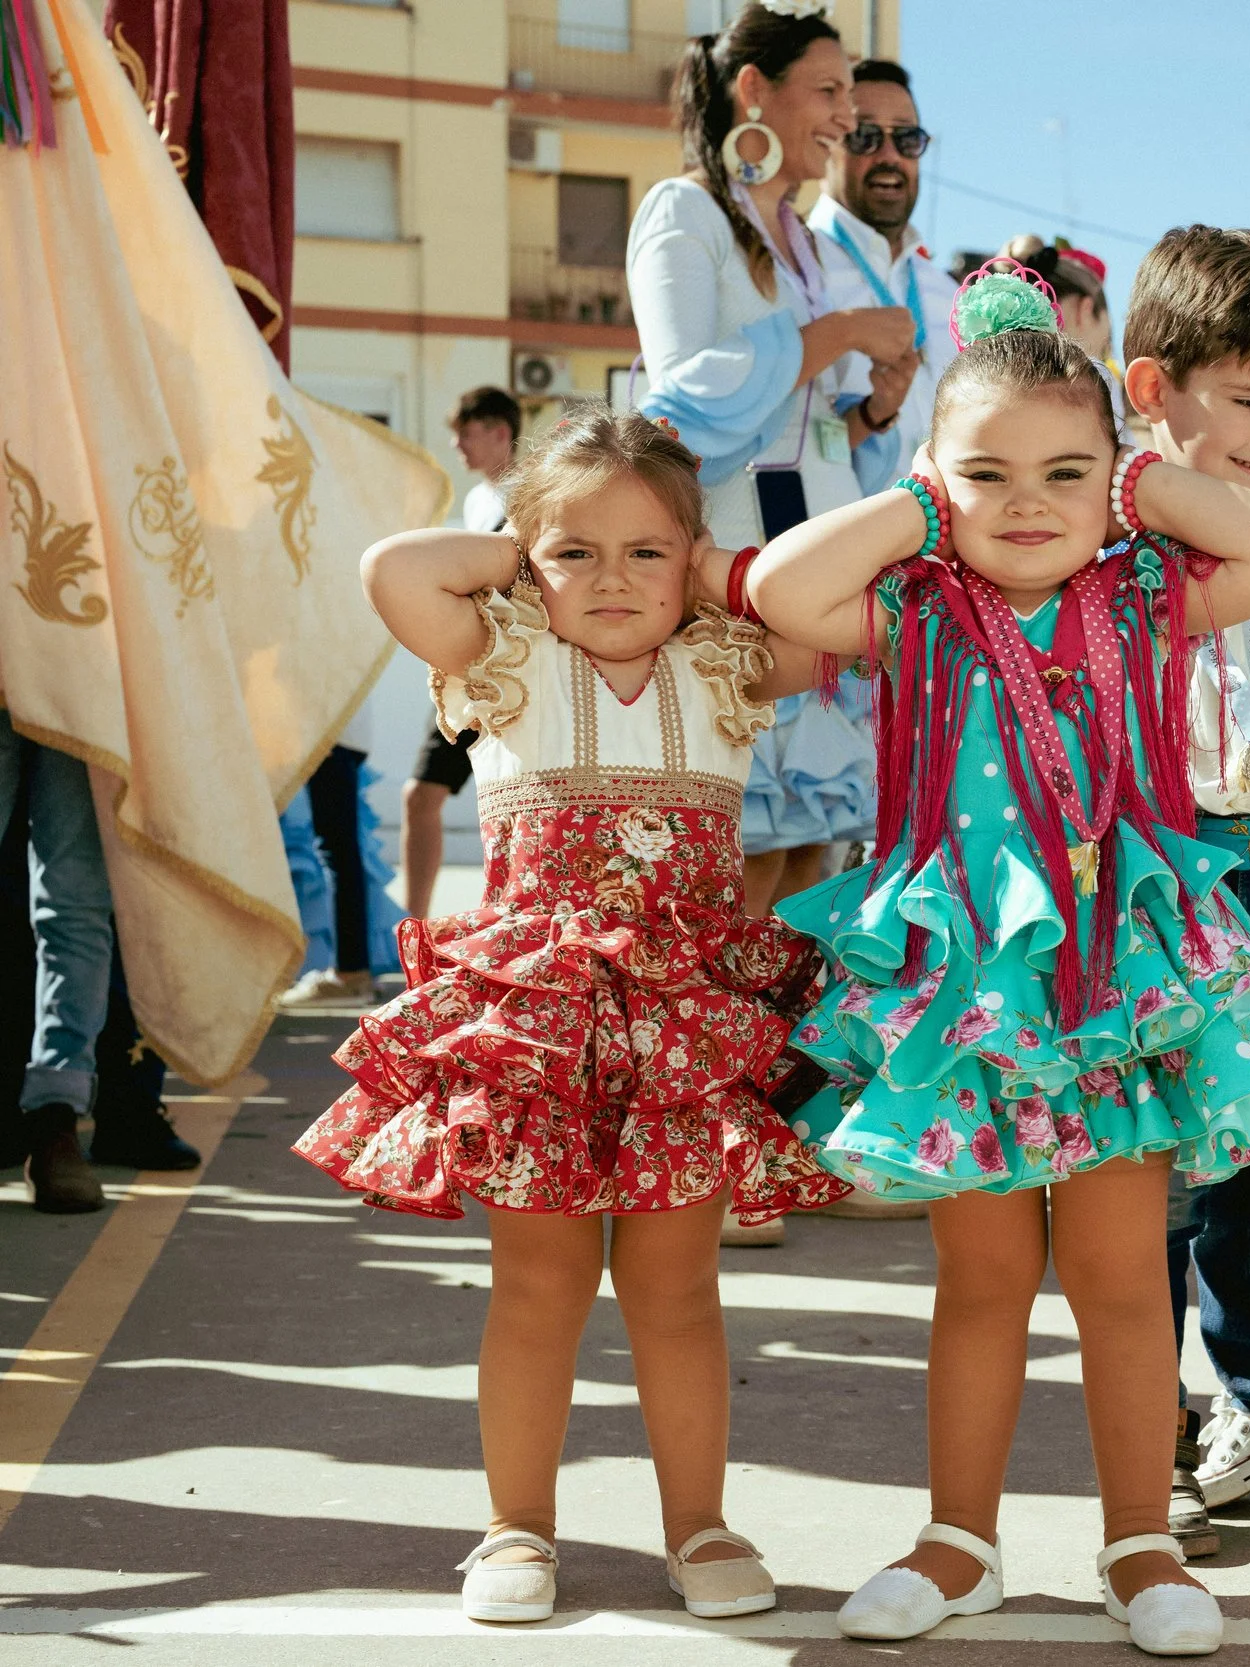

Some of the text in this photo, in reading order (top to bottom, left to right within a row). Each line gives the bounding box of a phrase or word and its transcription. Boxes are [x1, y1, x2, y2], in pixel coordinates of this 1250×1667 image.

[1004, 649, 1015, 659] la
[1208, 648, 1219, 668] Viva
[1007, 660, 1019, 669] de
[1015, 671, 1031, 702] Virgen
[1036, 730, 1047, 740] la
[1043, 740, 1054, 761] Viva
